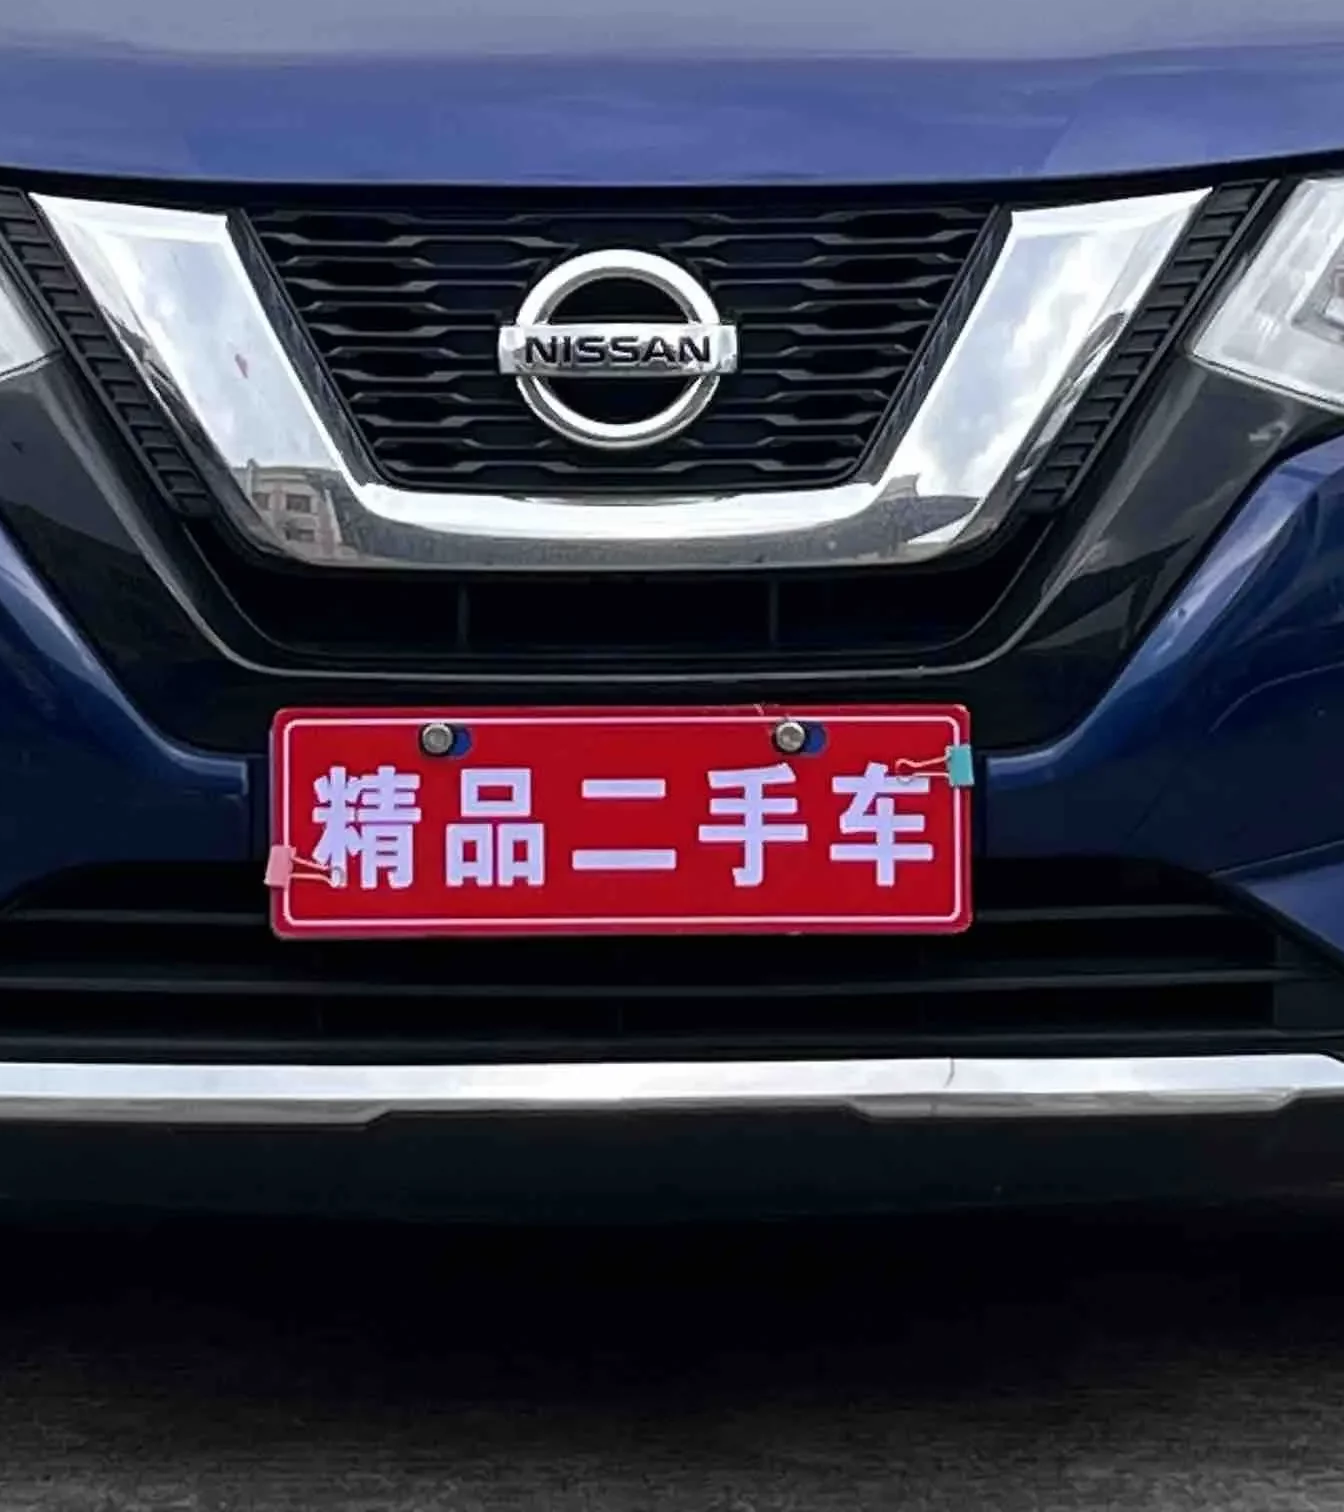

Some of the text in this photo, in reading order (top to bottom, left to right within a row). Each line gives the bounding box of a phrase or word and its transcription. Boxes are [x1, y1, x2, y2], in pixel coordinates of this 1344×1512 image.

[525, 335, 711, 364] NISSAN
[312, 763, 934, 891] 精品二手车
